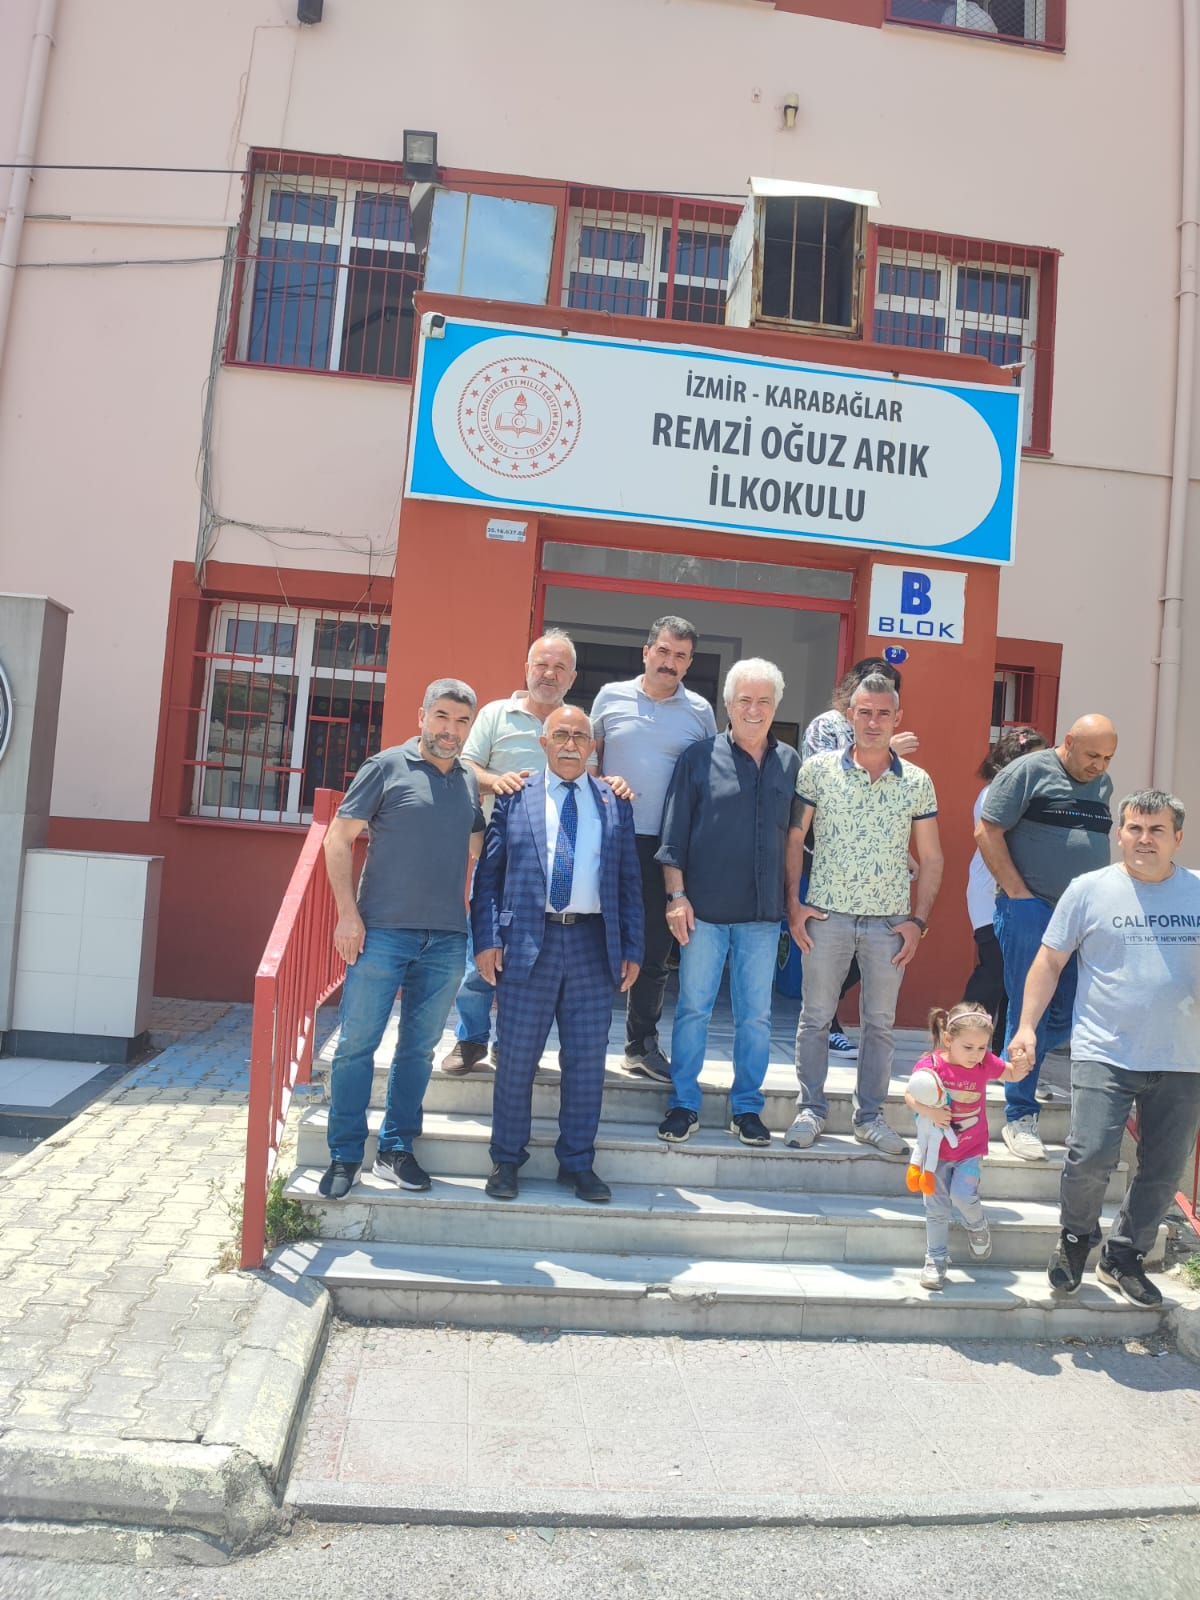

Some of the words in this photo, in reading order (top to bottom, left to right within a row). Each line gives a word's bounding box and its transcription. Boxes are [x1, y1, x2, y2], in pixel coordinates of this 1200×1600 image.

[686, 370, 747, 403] İZMİR
[765, 384, 903, 423] KARABAĞLAR
[652, 412, 752, 456] REMZİ
[761, 422, 847, 468] OĞUZ
[853, 438, 930, 478] ARIK
[709, 465, 866, 522] İLKOKULU
[901, 571, 931, 615] B
[878, 616, 955, 639] BLOK
